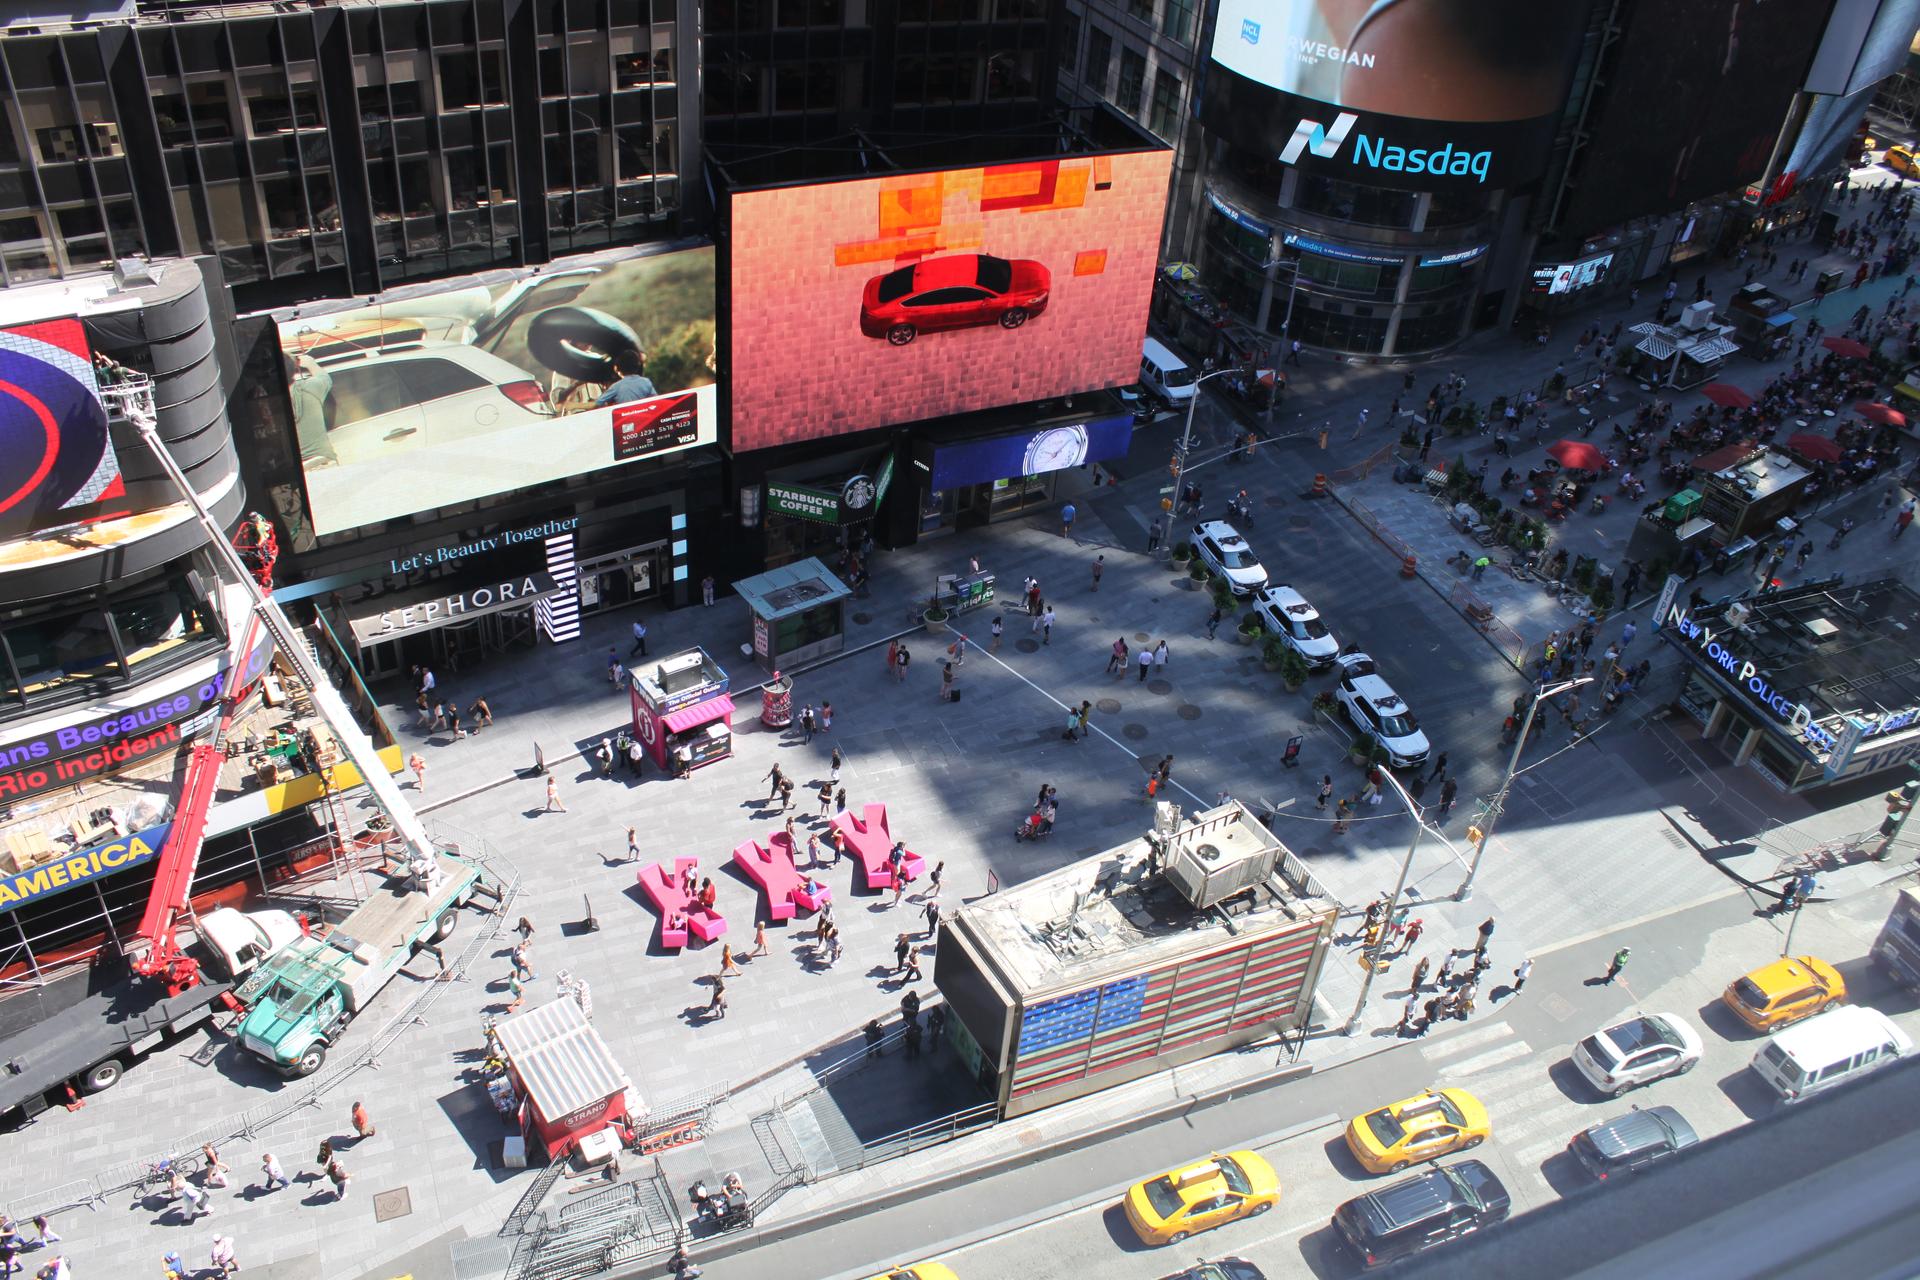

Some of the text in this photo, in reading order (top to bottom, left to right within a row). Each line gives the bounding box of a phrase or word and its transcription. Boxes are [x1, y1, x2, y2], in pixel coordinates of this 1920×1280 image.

[1243, 20, 1258, 37] NCL
[1353, 134, 1492, 183] Nasdaq
[1296, 239, 1323, 253] Nasdaq
[677, 434, 696, 444] VISA
[768, 487, 838, 509] STARBUCKS
[779, 500, 823, 515] COFFEE
[390, 516, 579, 574] Let's Beauty Together
[379, 576, 538, 633] SEPHORA
[1667, 602, 1837, 752] NEW YORK POLICE DEPT
[56, 694, 191, 750] Because
[198, 672, 224, 702] of
[668, 699, 680, 707] The
[0, 703, 222, 798] Rio incident ESP
[0, 836, 154, 904] AMERICA
[567, 1102, 606, 1125] STRAND
